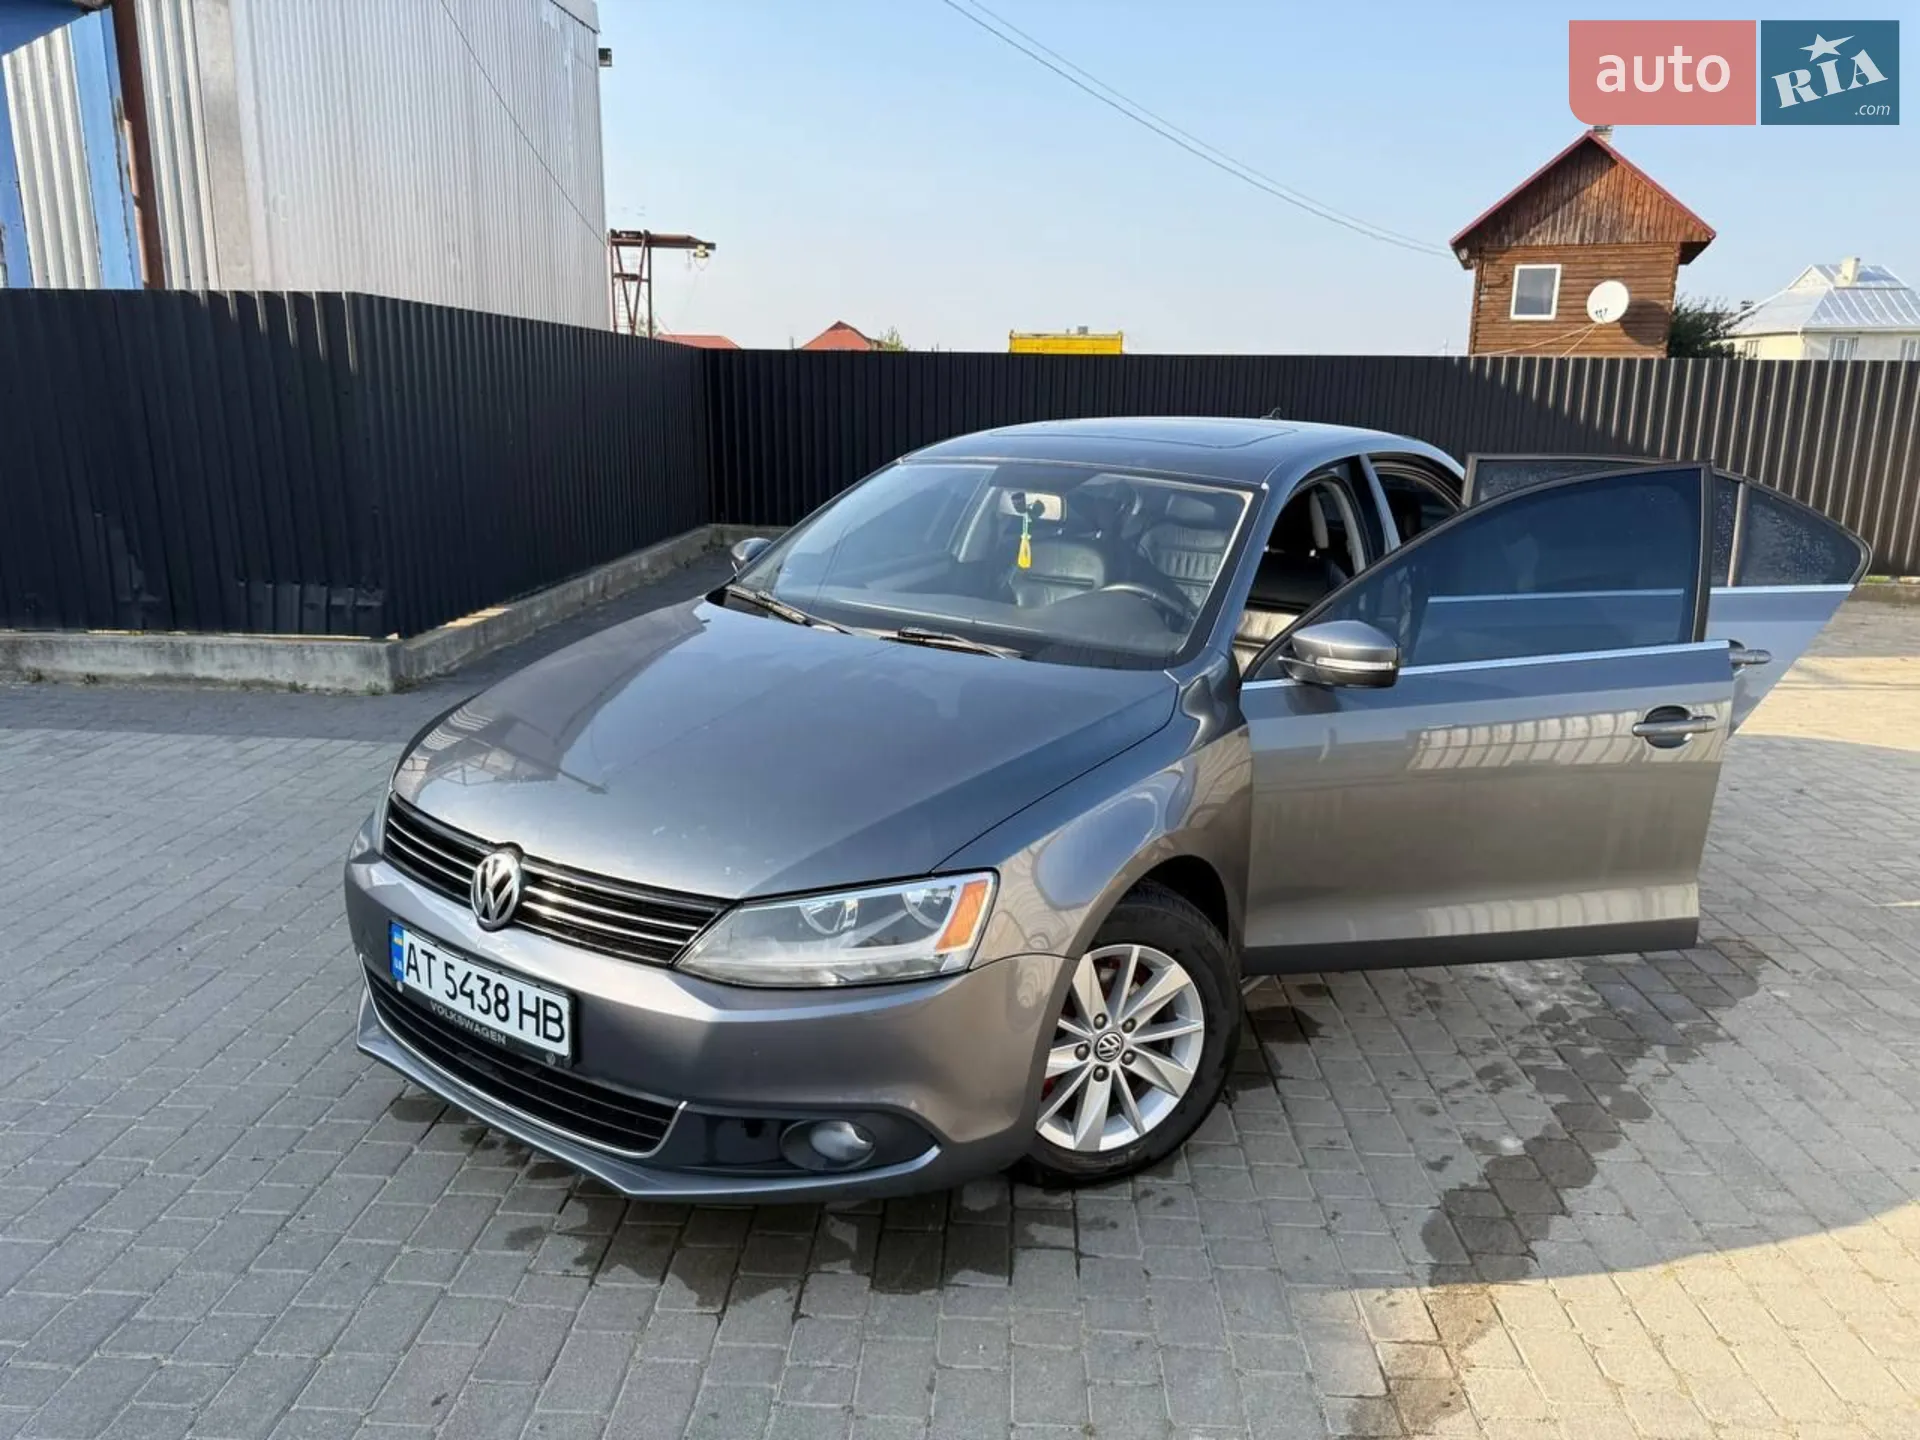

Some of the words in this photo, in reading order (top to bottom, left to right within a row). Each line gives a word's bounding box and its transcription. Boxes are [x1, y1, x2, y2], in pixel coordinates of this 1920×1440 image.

[406, 942, 436, 989] AT
[444, 961, 510, 1023] 5438
[518, 990, 566, 1044] HB
[430, 1001, 507, 1046] VOLKSWAGEN
